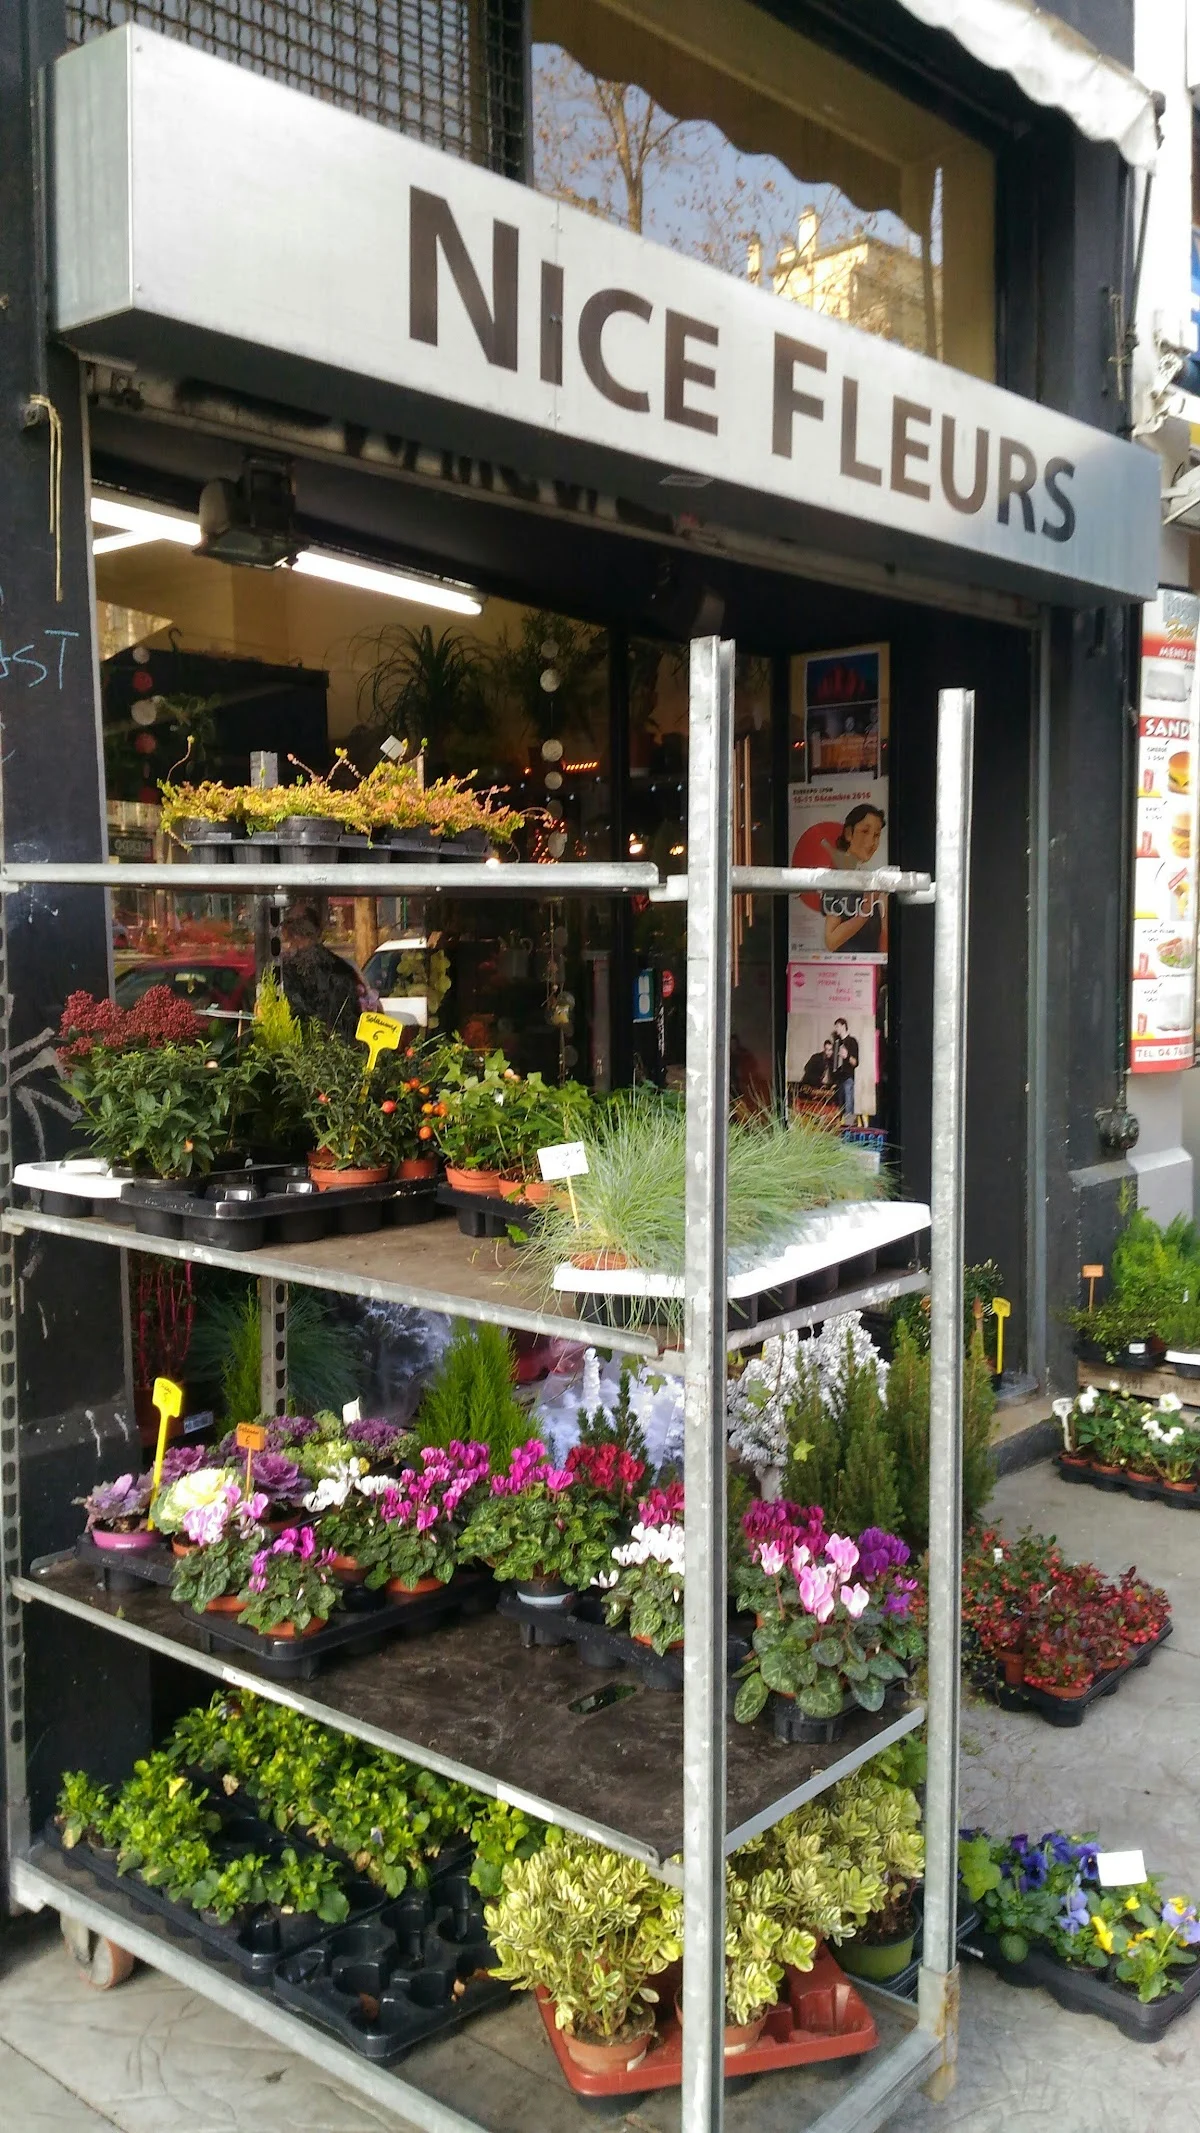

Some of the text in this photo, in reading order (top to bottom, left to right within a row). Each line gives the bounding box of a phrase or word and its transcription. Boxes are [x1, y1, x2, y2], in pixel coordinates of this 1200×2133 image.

[409, 184, 719, 437] NICE
[771, 330, 1076, 543] FLEURS
[852, 791, 872, 800] 2016
[822, 891, 885, 919] touch
